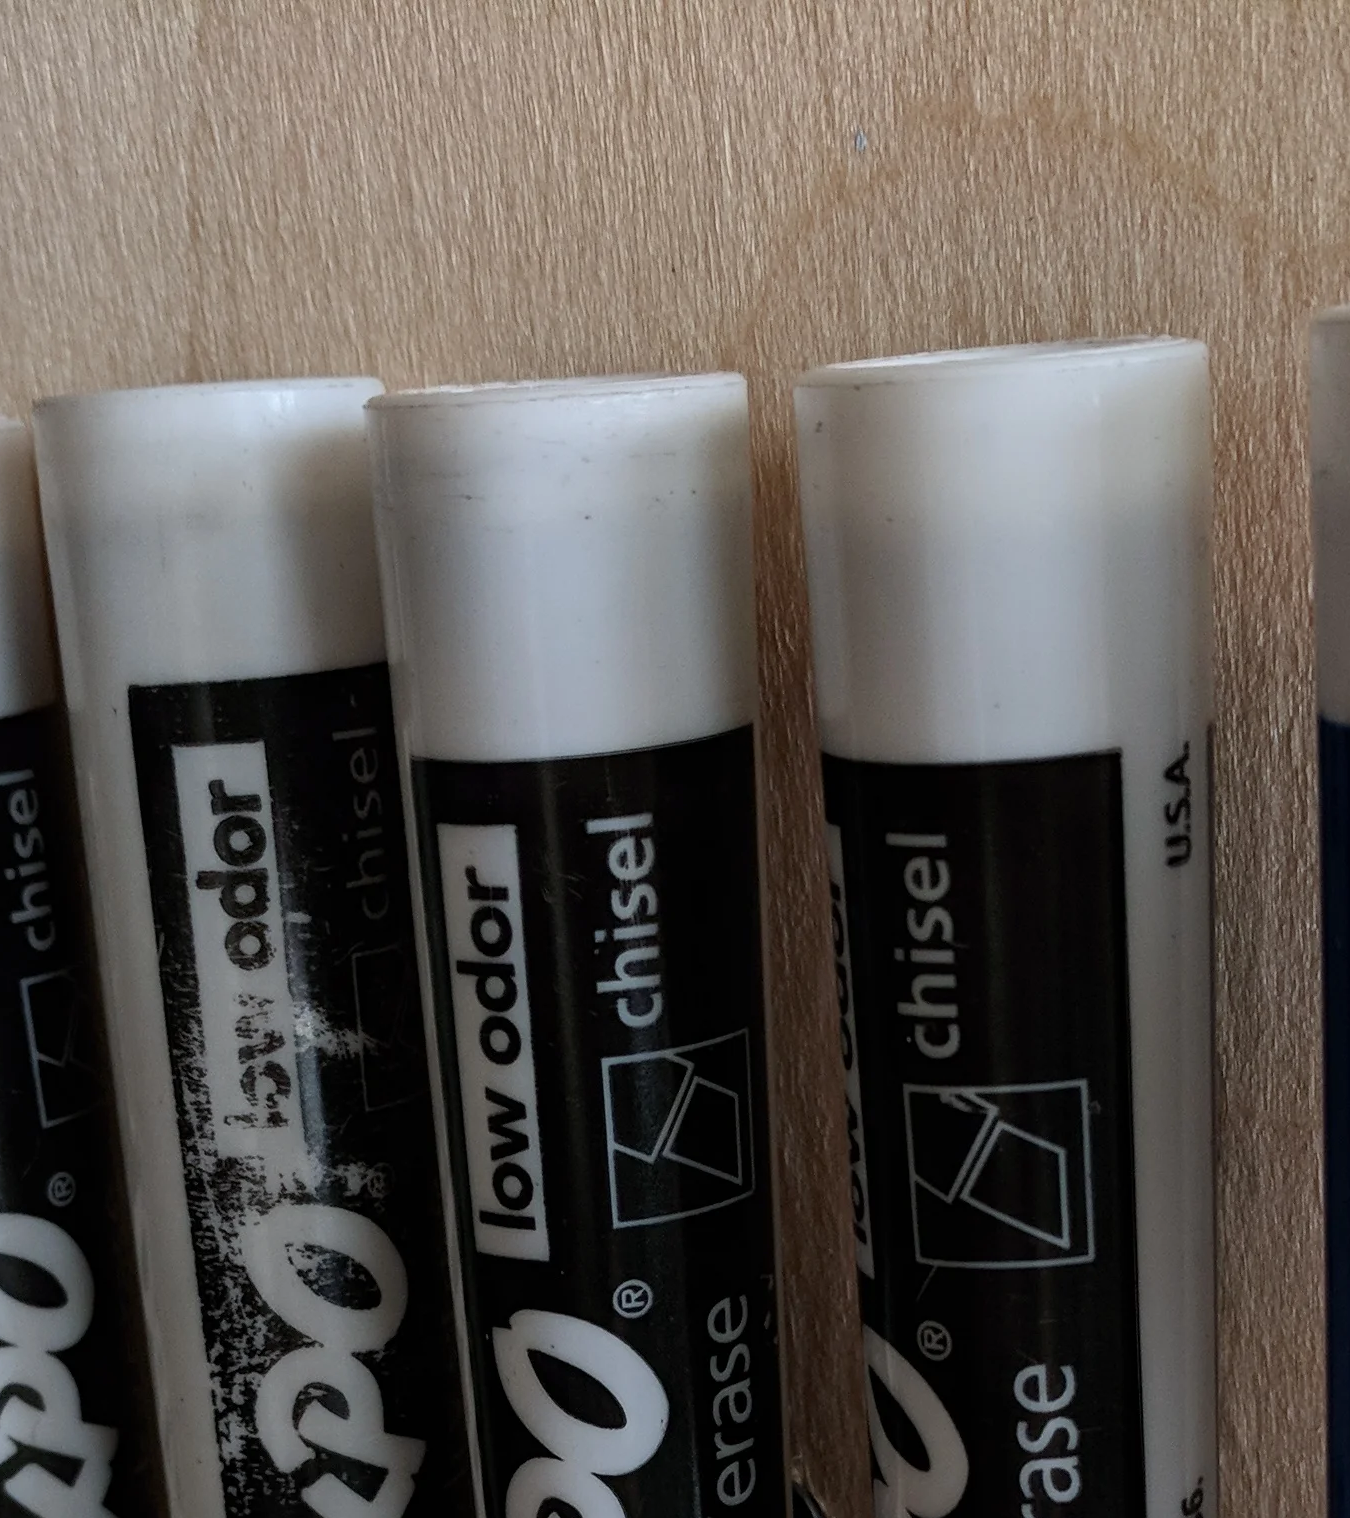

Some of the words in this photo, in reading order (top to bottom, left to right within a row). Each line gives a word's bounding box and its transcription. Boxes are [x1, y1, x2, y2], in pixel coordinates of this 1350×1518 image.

[196, 778, 277, 972] odor
[332, 724, 391, 922] chisel
[1163, 740, 1192, 867] U.S.A.
[456, 864, 522, 1066] odor
[585, 811, 663, 1029] chisel
[885, 832, 961, 1060] chisel
[479, 1087, 536, 1231] low
[706, 1294, 758, 1507] erase
